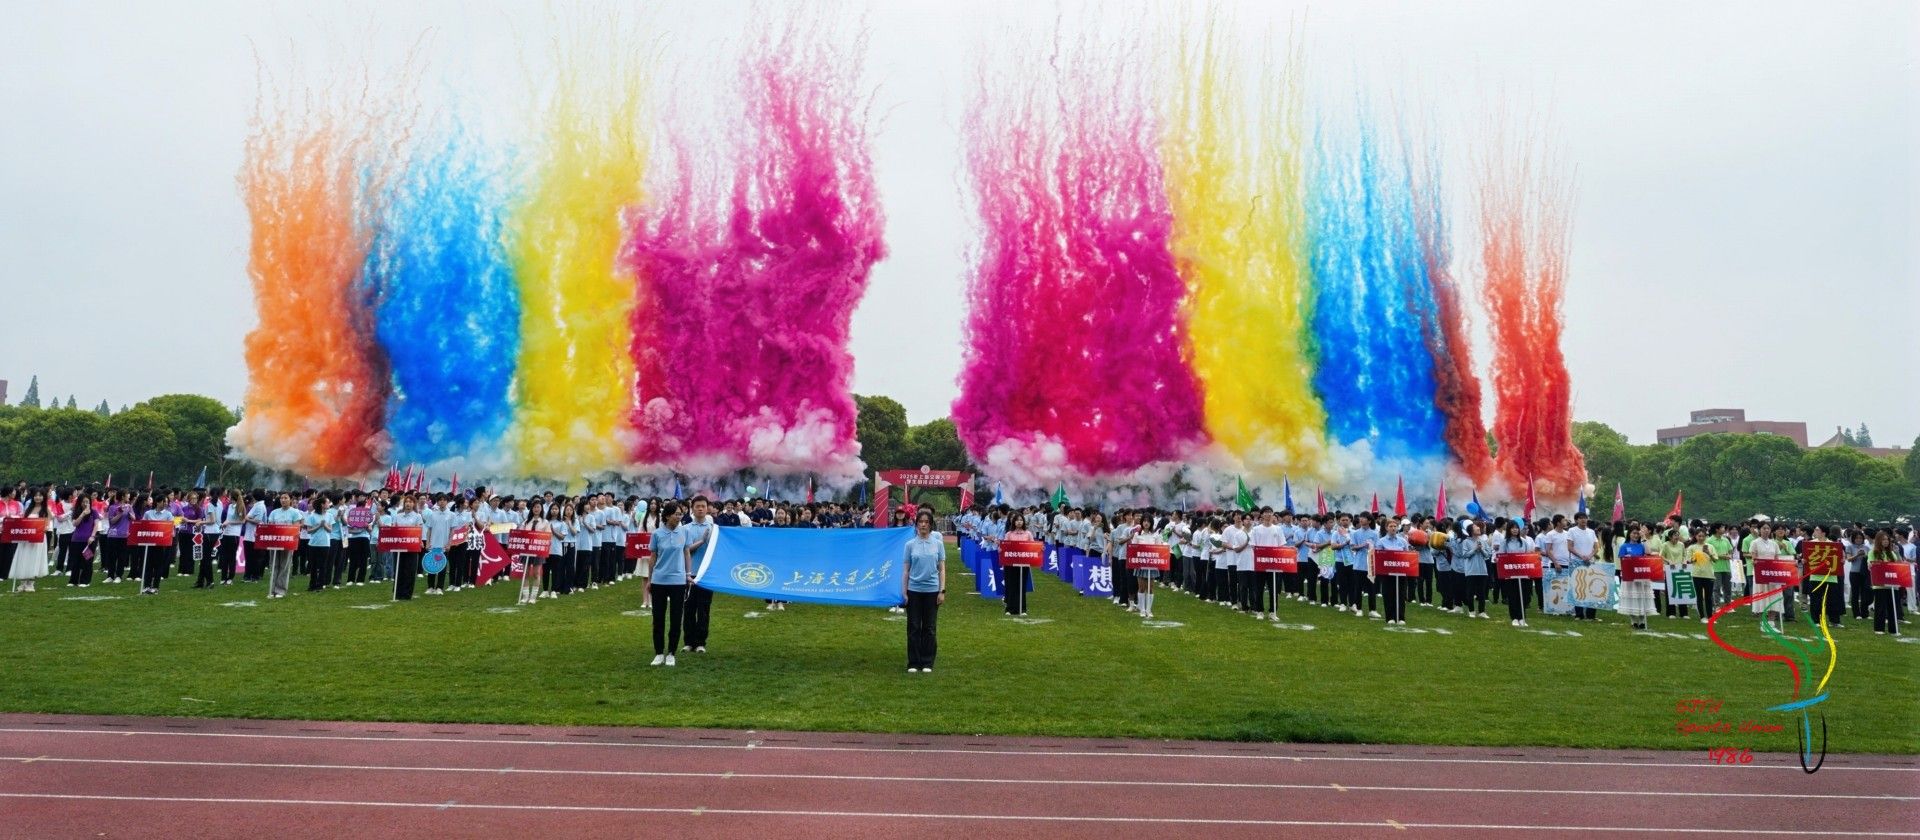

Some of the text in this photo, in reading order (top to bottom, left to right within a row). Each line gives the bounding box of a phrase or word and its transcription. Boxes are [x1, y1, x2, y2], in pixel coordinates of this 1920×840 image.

[1808, 544, 1839, 572] 药
[783, 559, 892, 586] 上海交通大学
[1088, 565, 1114, 592] 想
[1671, 569, 1697, 599] 肩
